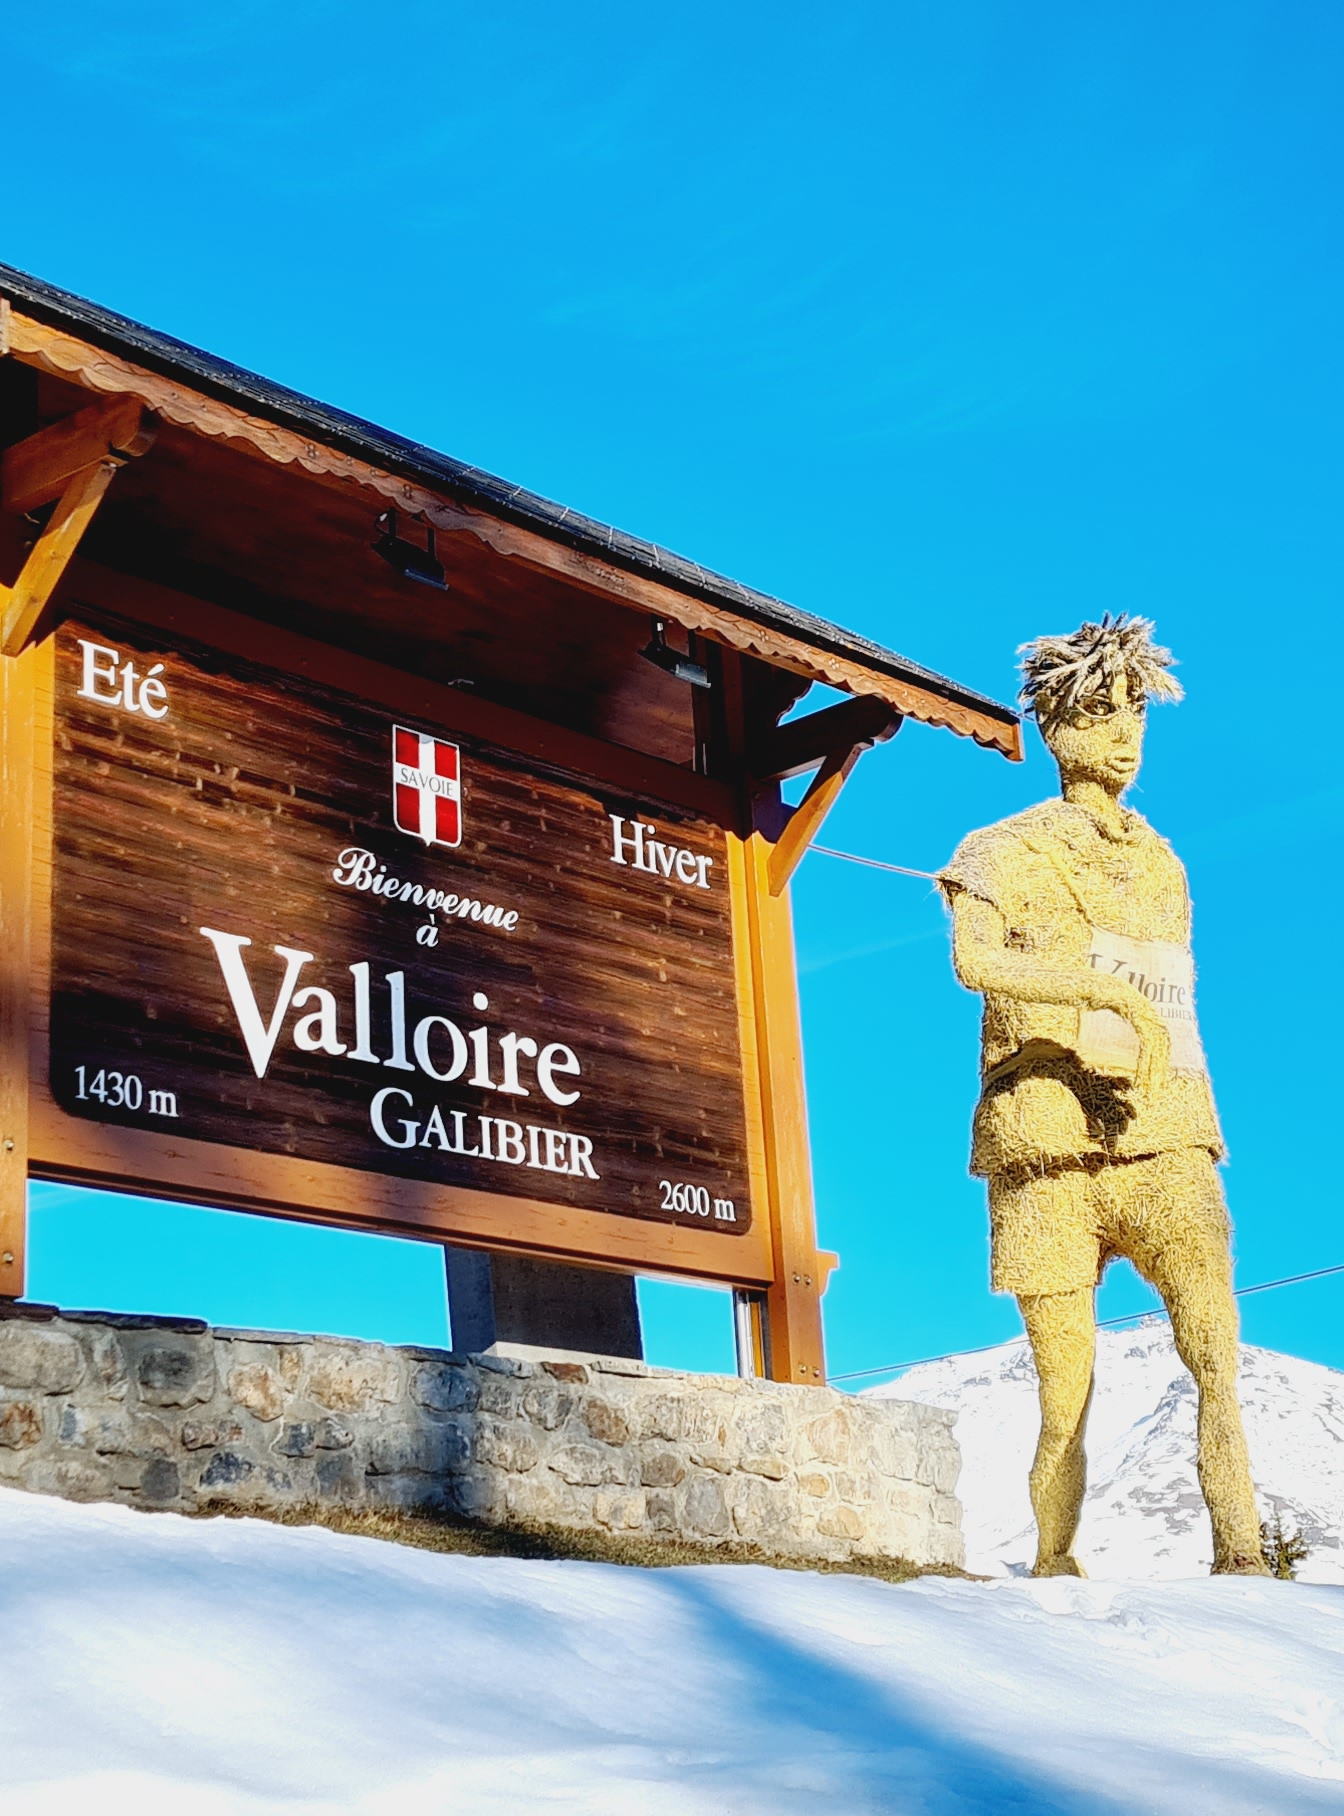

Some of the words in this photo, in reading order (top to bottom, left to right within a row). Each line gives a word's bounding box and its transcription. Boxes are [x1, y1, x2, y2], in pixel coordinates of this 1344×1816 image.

[76, 639, 169, 721] Eté
[400, 766, 455, 797] SAVOIE
[608, 813, 714, 890] Hiver
[332, 847, 519, 932] Bienvenue
[415, 913, 439, 947] à
[1088, 952, 1187, 1006] loire
[198, 926, 582, 1106] Valloire
[74, 1065, 143, 1111] 1430
[148, 1089, 179, 1118] m
[369, 1087, 601, 1180] GALIBIER
[658, 1179, 710, 1217] 2600
[713, 1198, 737, 1222] m
